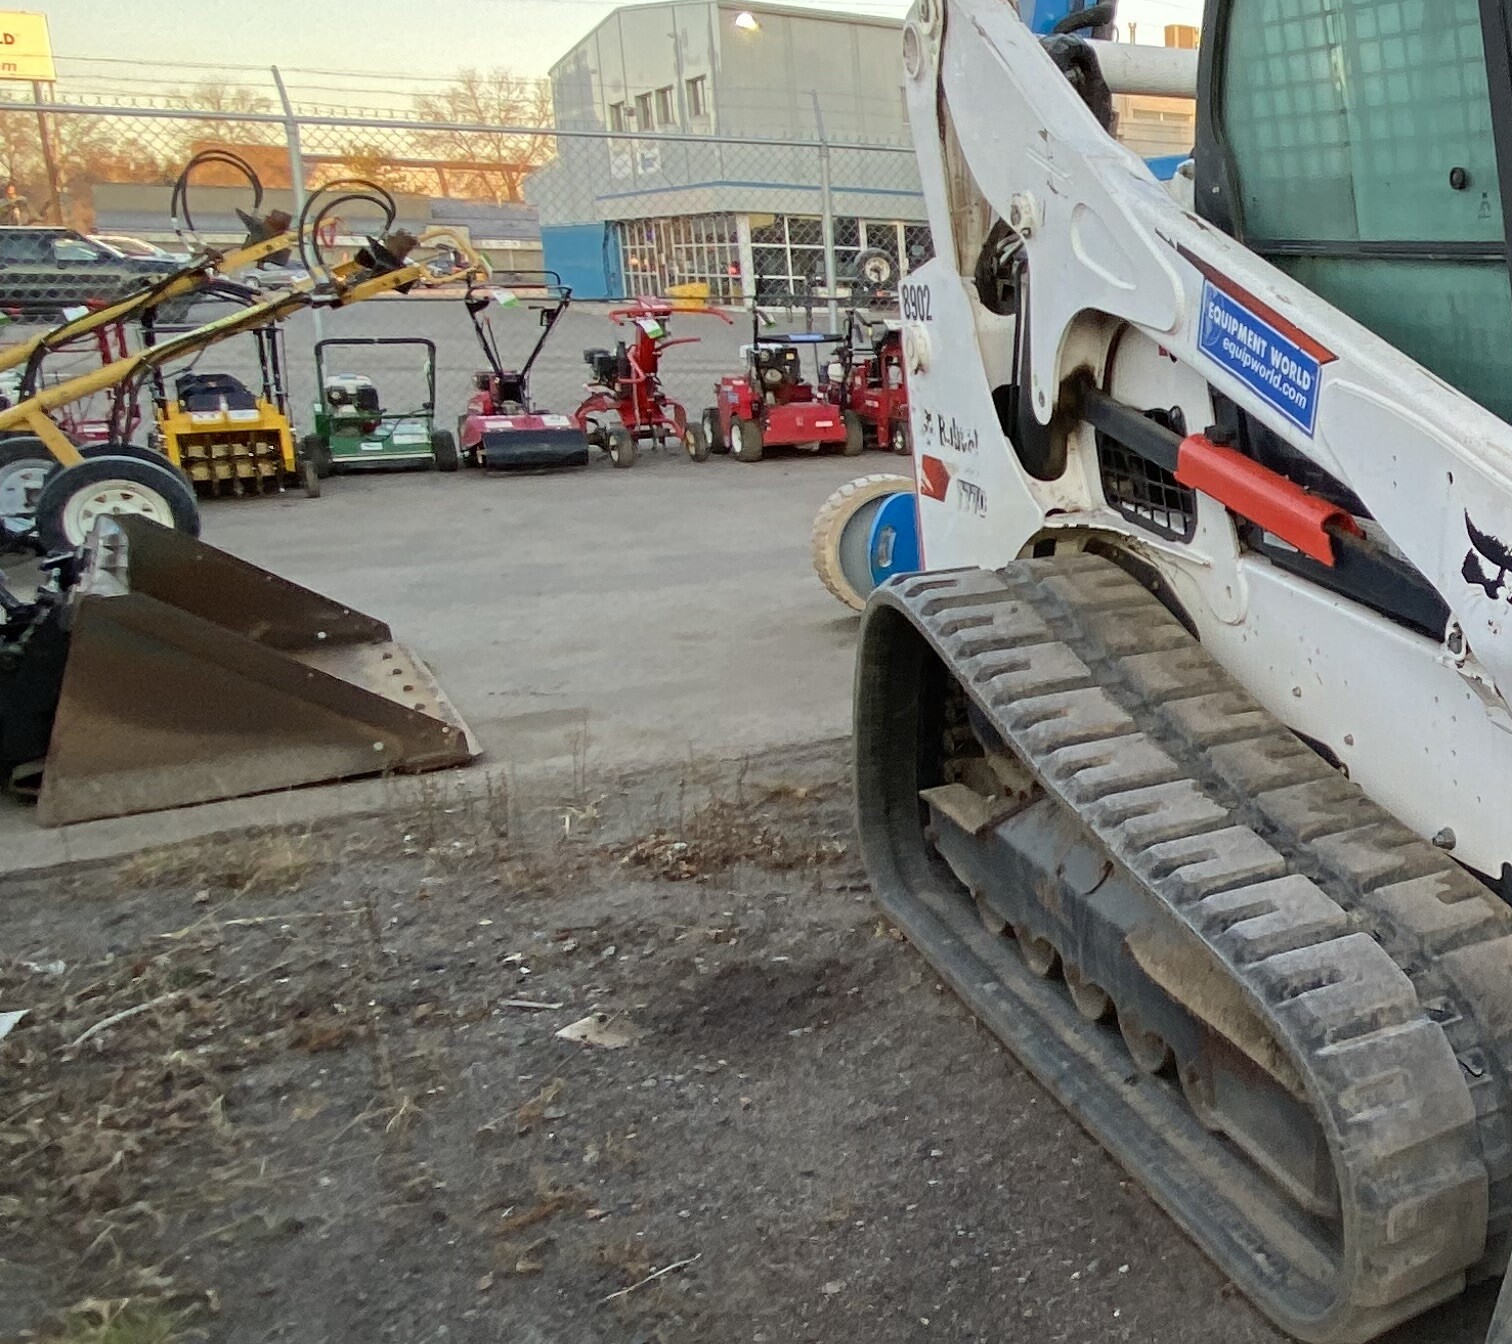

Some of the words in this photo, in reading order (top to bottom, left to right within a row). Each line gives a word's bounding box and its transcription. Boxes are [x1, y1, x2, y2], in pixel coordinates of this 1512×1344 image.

[902, 284, 933, 322] 8902
[1207, 301, 1268, 359] EQUIPMENT
[1270, 345, 1311, 391] WORLD
[1222, 337, 1307, 410] equipworld.com
